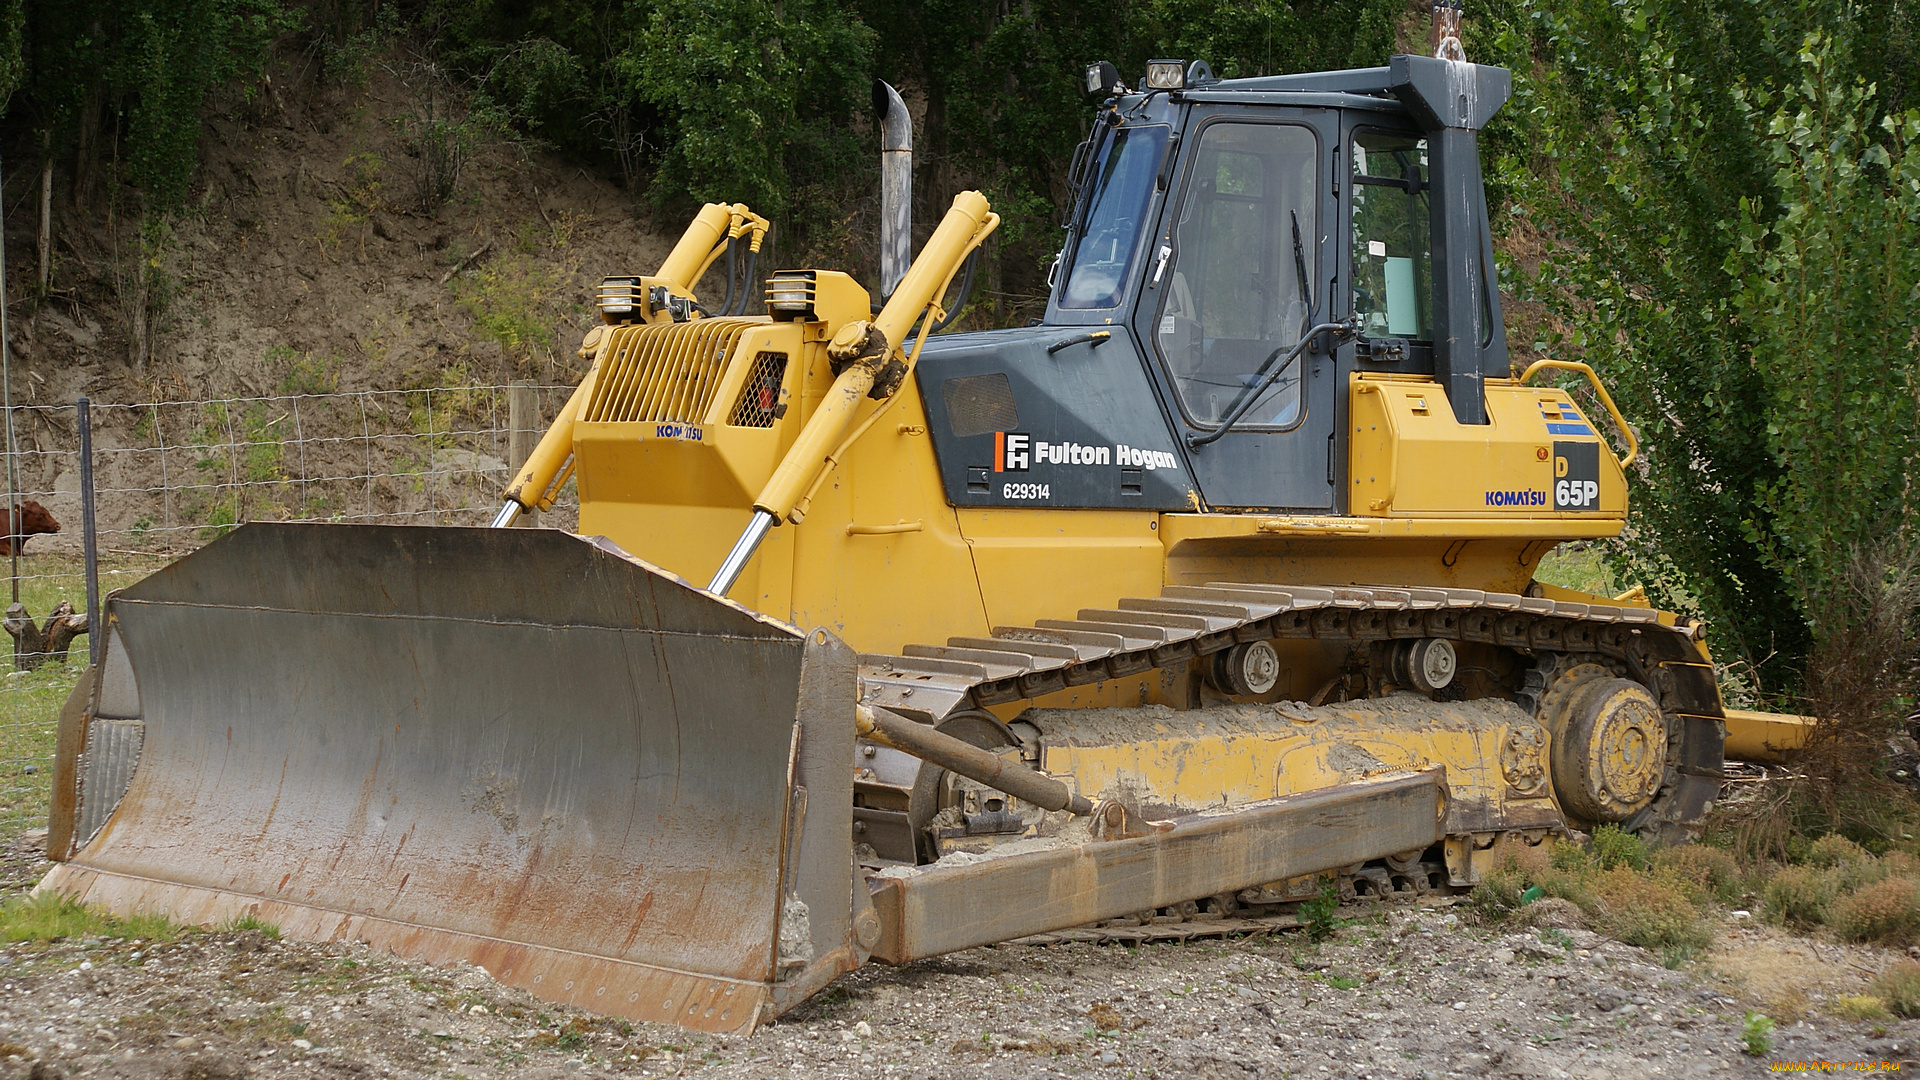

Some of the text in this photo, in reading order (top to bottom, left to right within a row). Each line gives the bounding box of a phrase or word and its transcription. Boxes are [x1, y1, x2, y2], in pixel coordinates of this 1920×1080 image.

[1035, 441, 1178, 470] Fulton Hogan
[1555, 456, 1569, 478] D
[1003, 483, 1050, 499] 629314
[1485, 487, 1546, 506] KOMATSU
[1556, 480, 1598, 507] 65P
